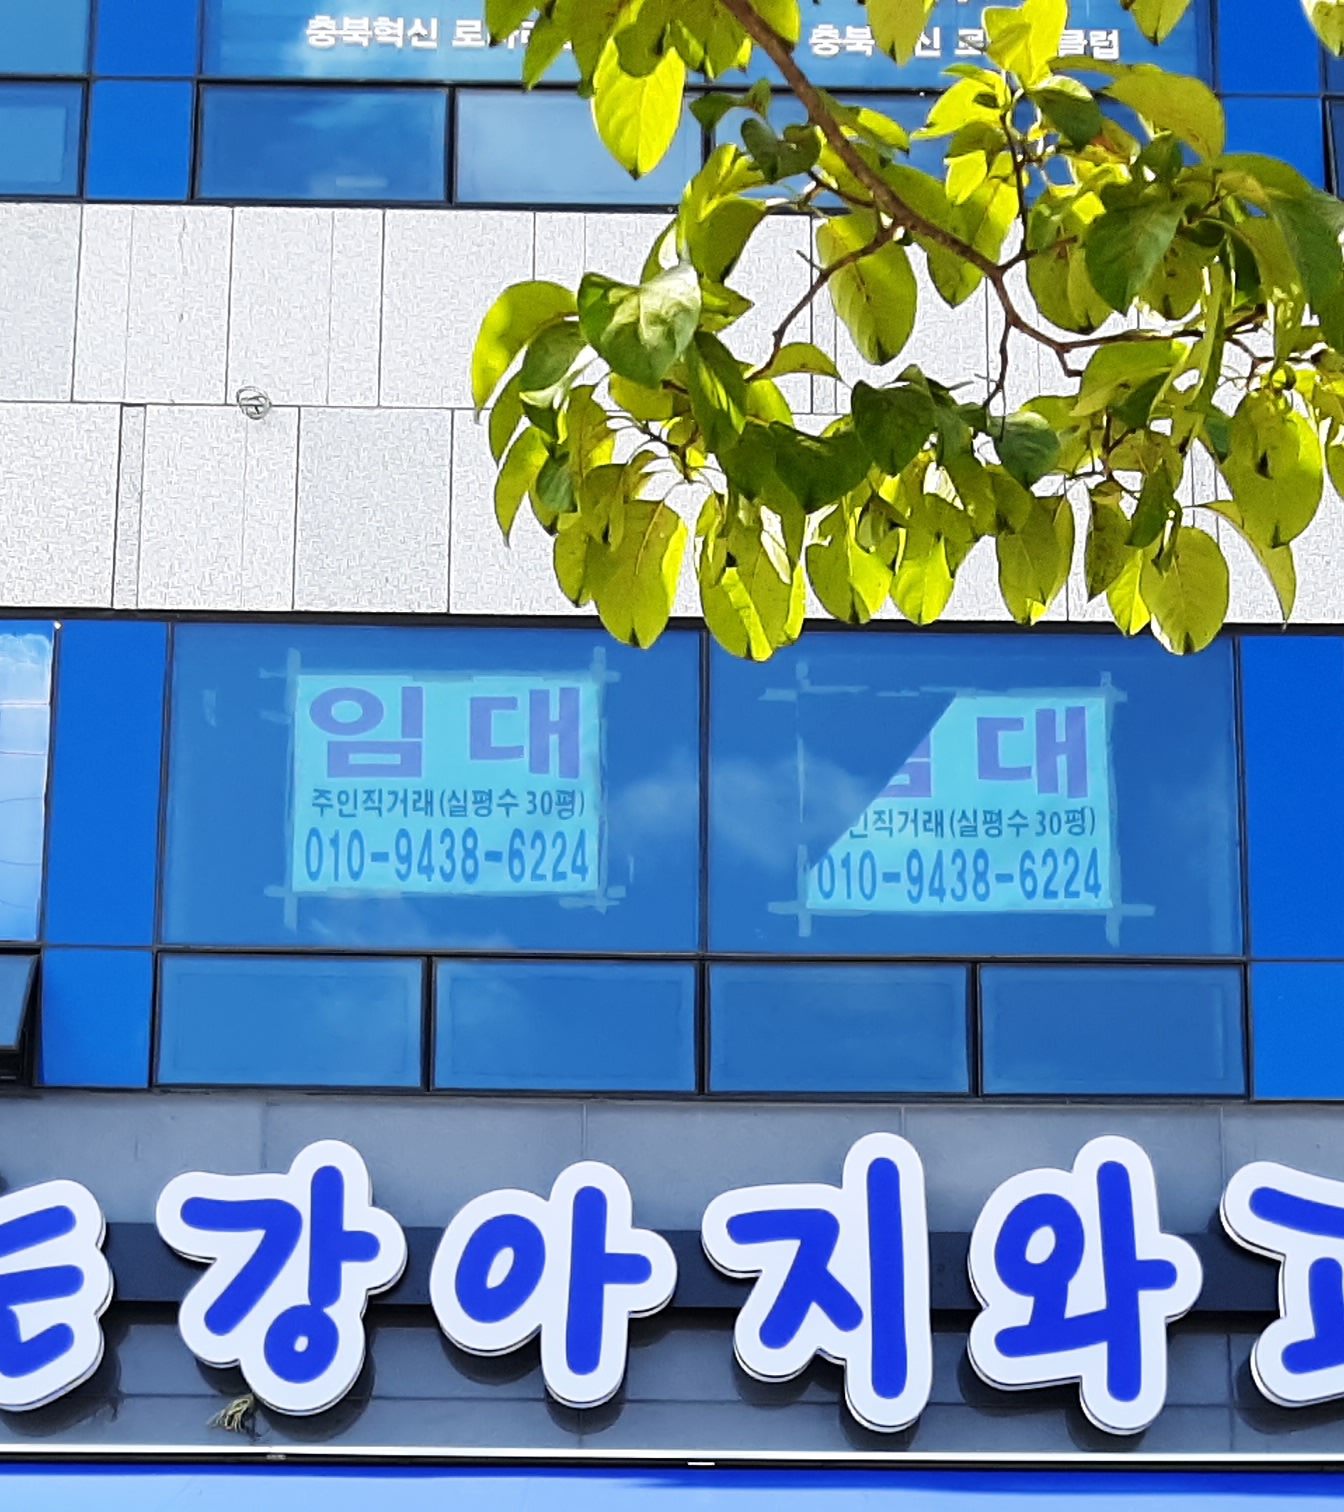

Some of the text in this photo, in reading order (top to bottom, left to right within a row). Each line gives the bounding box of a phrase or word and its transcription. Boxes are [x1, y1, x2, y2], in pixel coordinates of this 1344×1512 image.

[306, 15, 438, 48] 충북혁신
[808, 24, 942, 57] 충북신
[305, 827, 589, 884] 010-9438-6224
[816, 848, 1103, 904] 010-9438-6224
